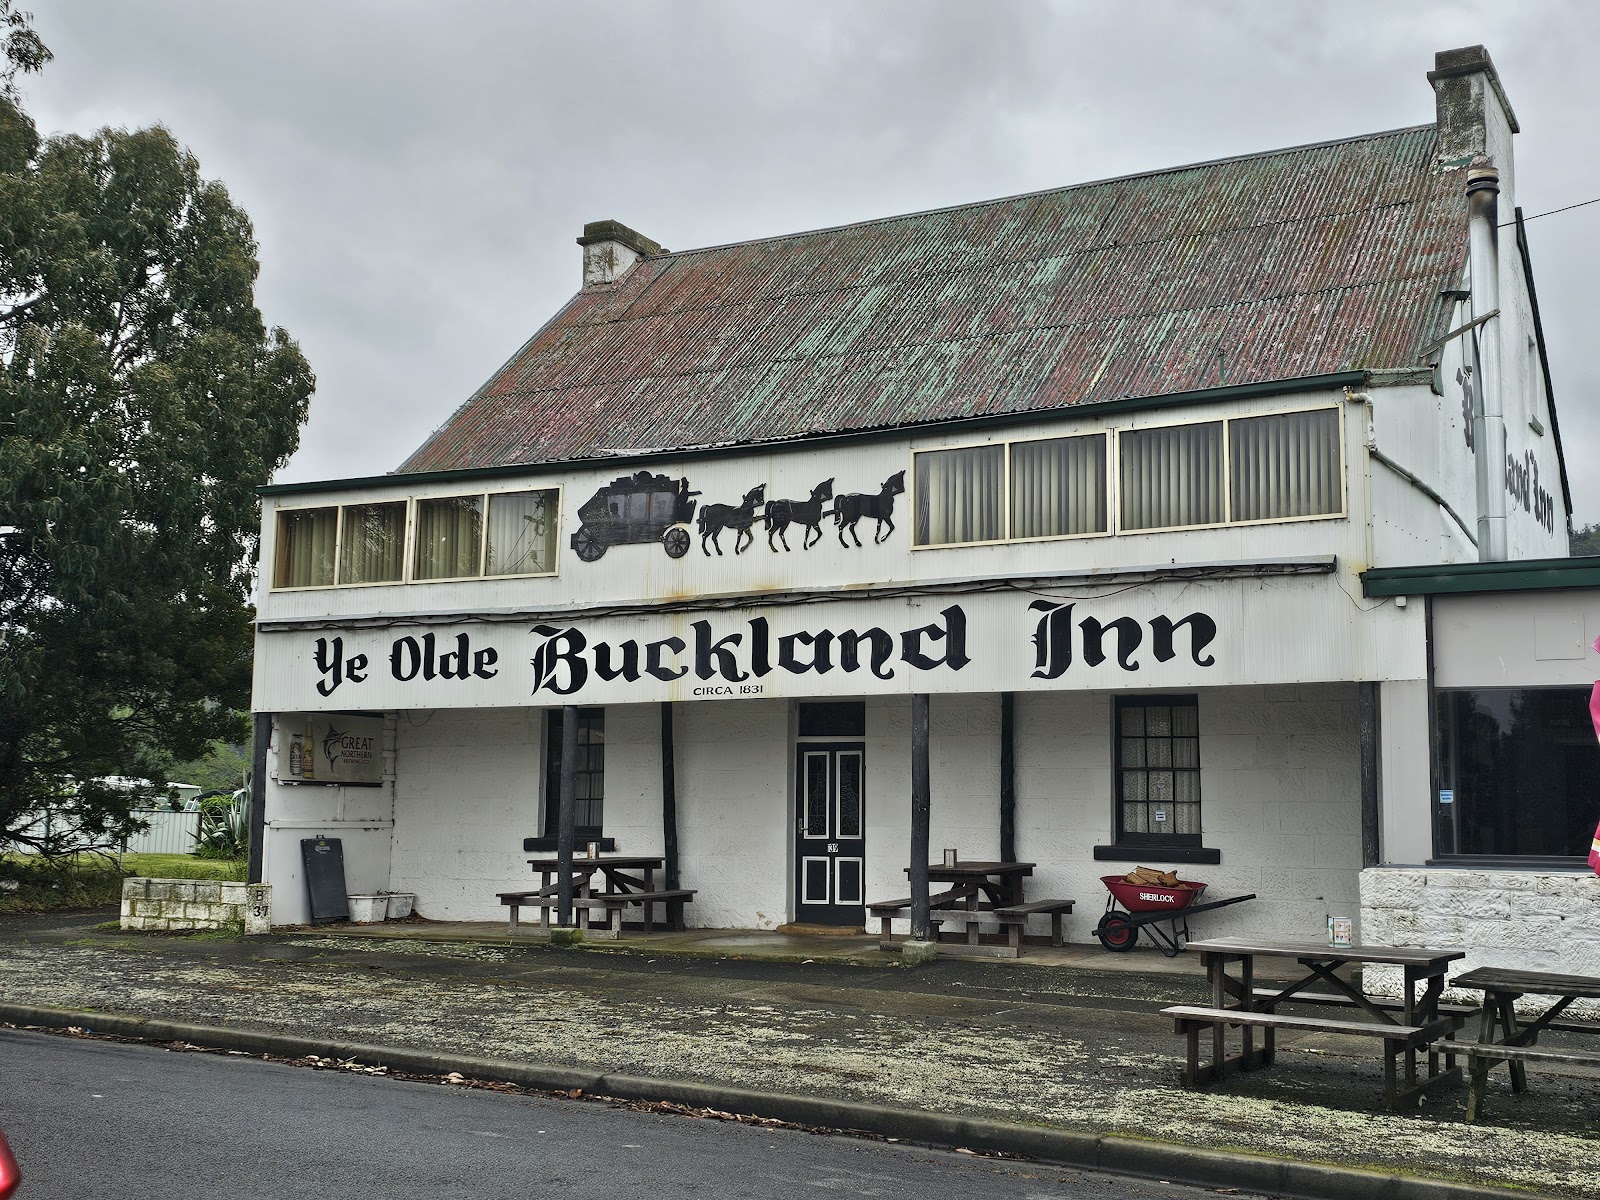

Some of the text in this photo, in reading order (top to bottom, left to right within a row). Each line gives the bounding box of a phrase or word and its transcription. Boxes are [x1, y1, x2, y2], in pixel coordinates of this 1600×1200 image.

[313, 600, 1217, 697] Ye Olde Buckland Inn
[693, 685, 764, 696] CIRCA 1831
[341, 736, 374, 750] GREAT
[341, 750, 372, 759] NORTHERN
[256, 890, 264, 901] B
[1139, 892, 1175, 903] SHERLOCK
[253, 905, 269, 917] 37
